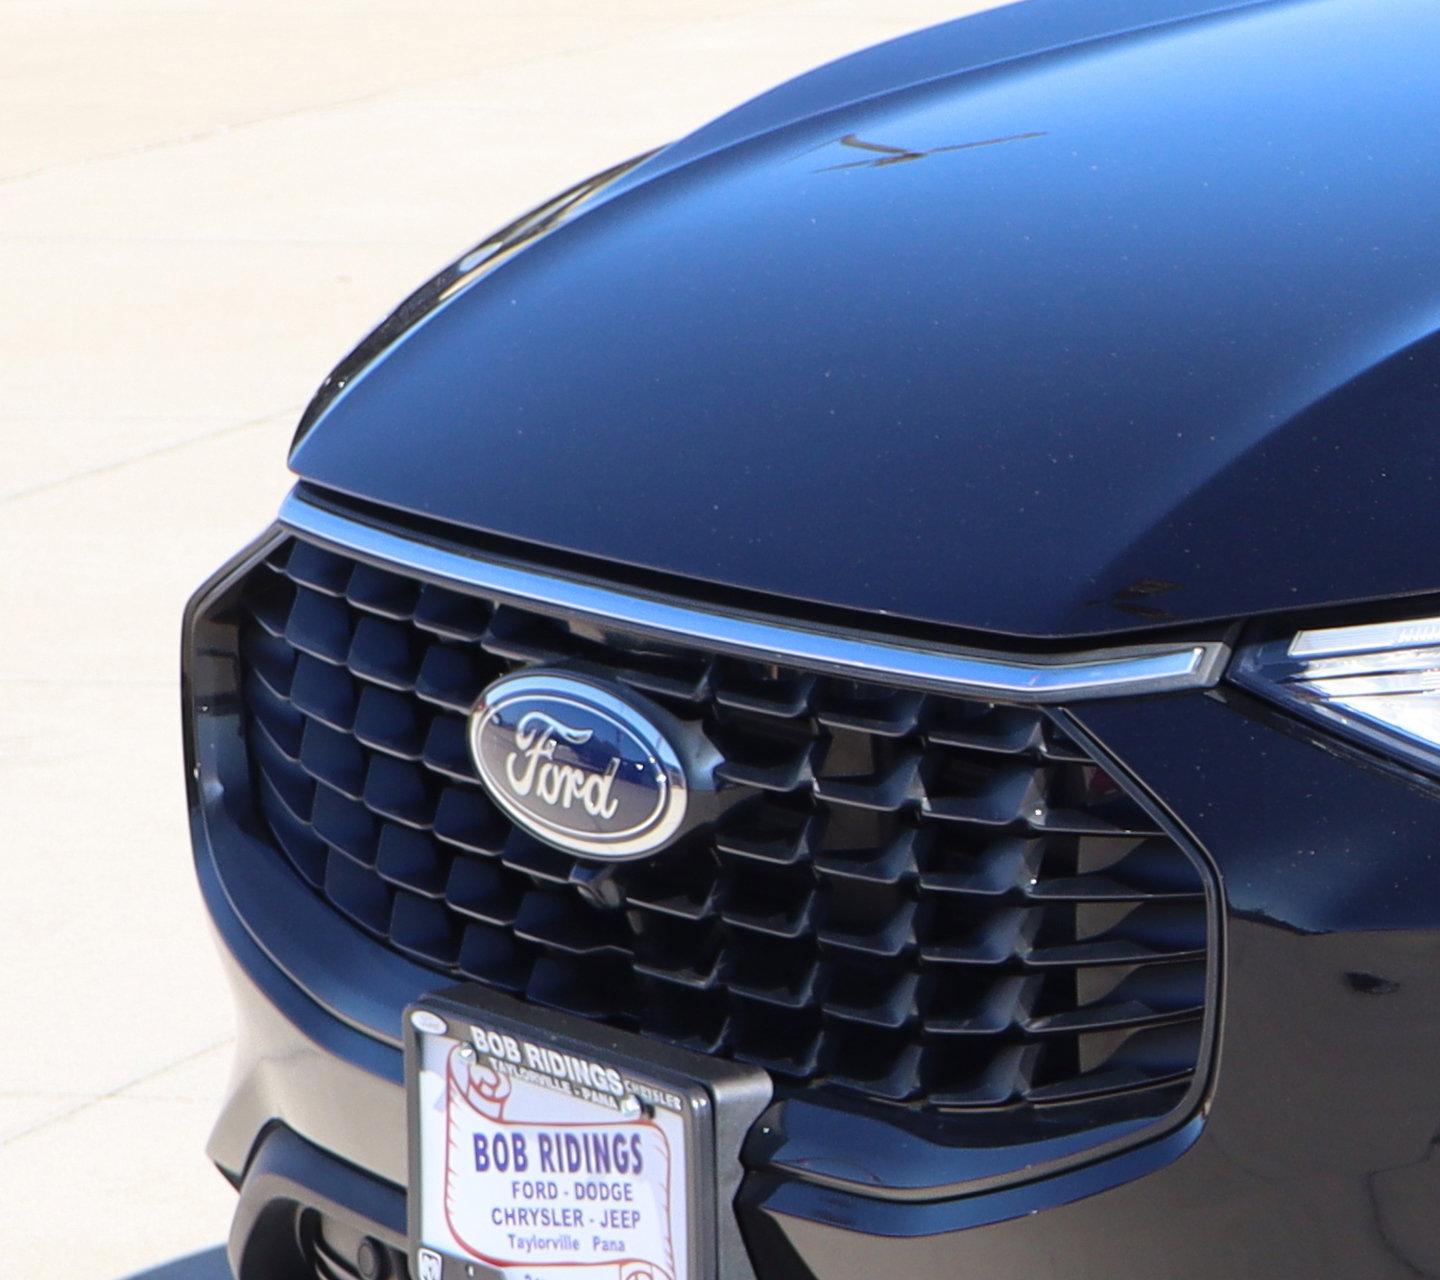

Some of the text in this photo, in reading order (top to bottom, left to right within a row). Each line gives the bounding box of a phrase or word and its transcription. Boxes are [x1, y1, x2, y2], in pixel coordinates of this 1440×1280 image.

[506, 710, 621, 819] Ford
[470, 1025, 626, 1096] BOB RIDINGS
[581, 1085, 619, 1110] PANA
[473, 1132, 643, 1175] BOB RIDINGS
[511, 1180, 559, 1200] FORD
[574, 1181, 634, 1201] DODGE
[491, 1207, 585, 1228] CHRYSLER
[600, 1209, 641, 1229] JEEP
[507, 1233, 626, 1253] Taylorville Pana
